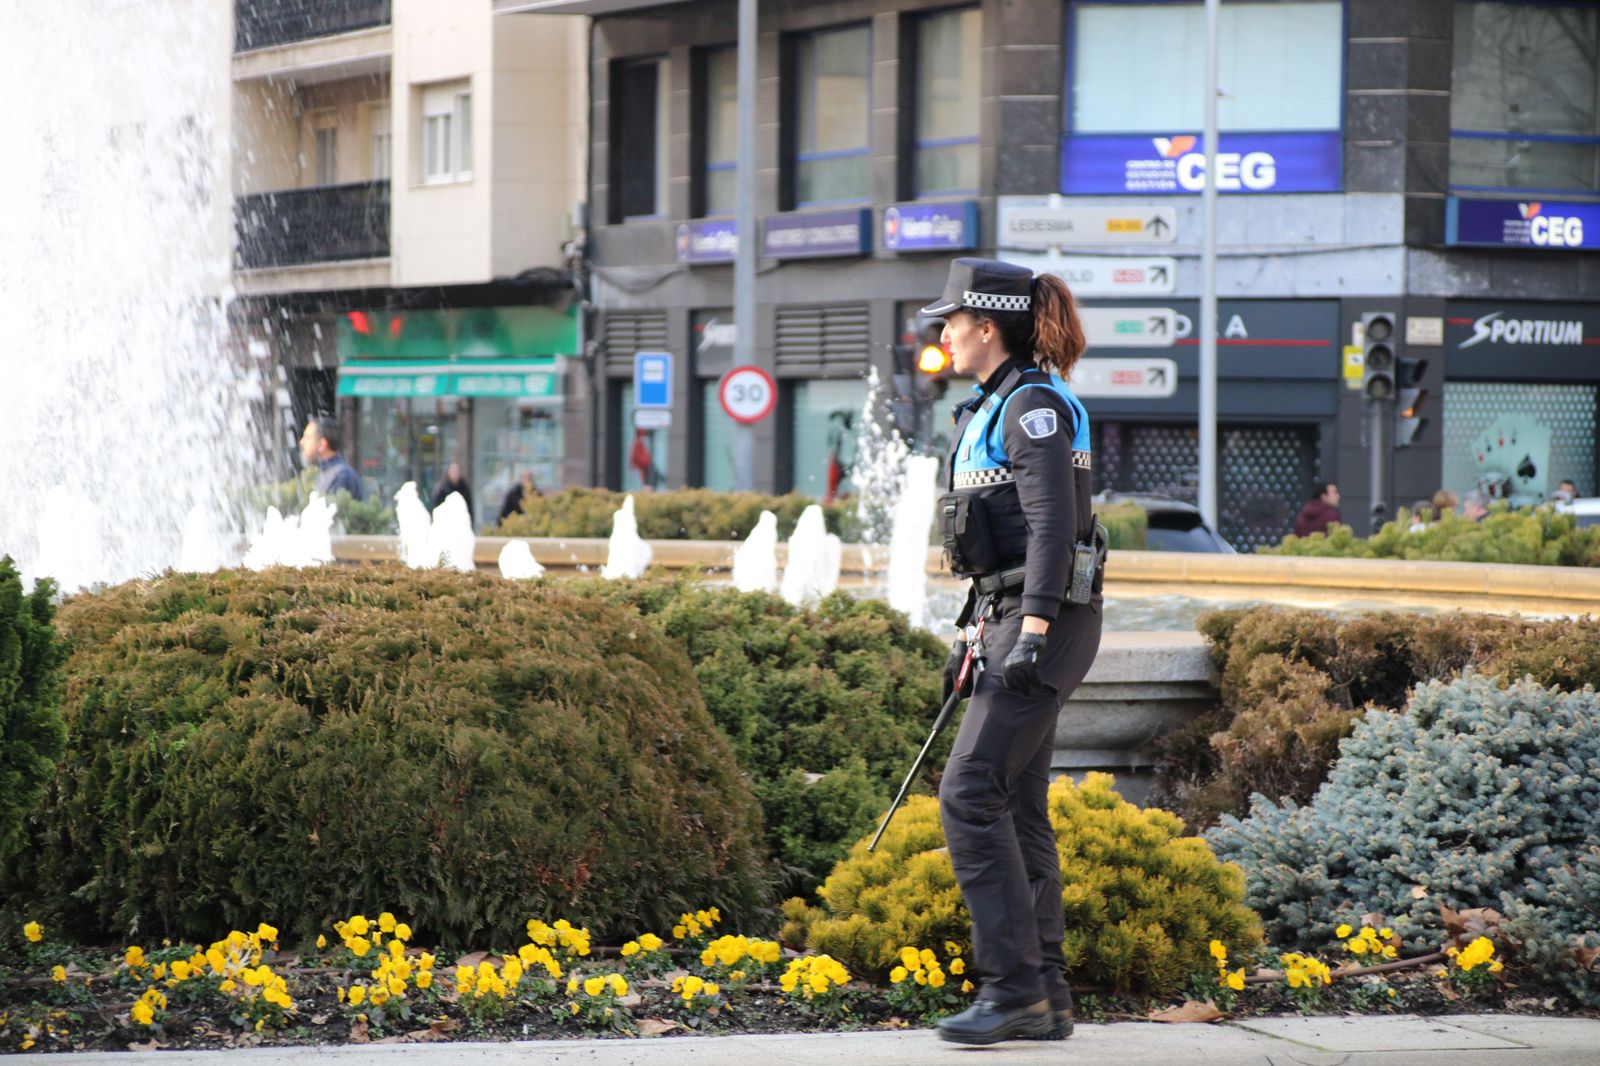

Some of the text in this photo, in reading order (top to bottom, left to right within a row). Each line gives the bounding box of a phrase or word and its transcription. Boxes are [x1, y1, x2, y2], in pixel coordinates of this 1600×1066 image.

[1176, 151, 1277, 191] CEG
[1010, 218, 1075, 232] LEDESMA
[1531, 215, 1583, 247] CEG
[1457, 311, 1584, 349] SPORTIUM
[733, 384, 763, 402] 30
